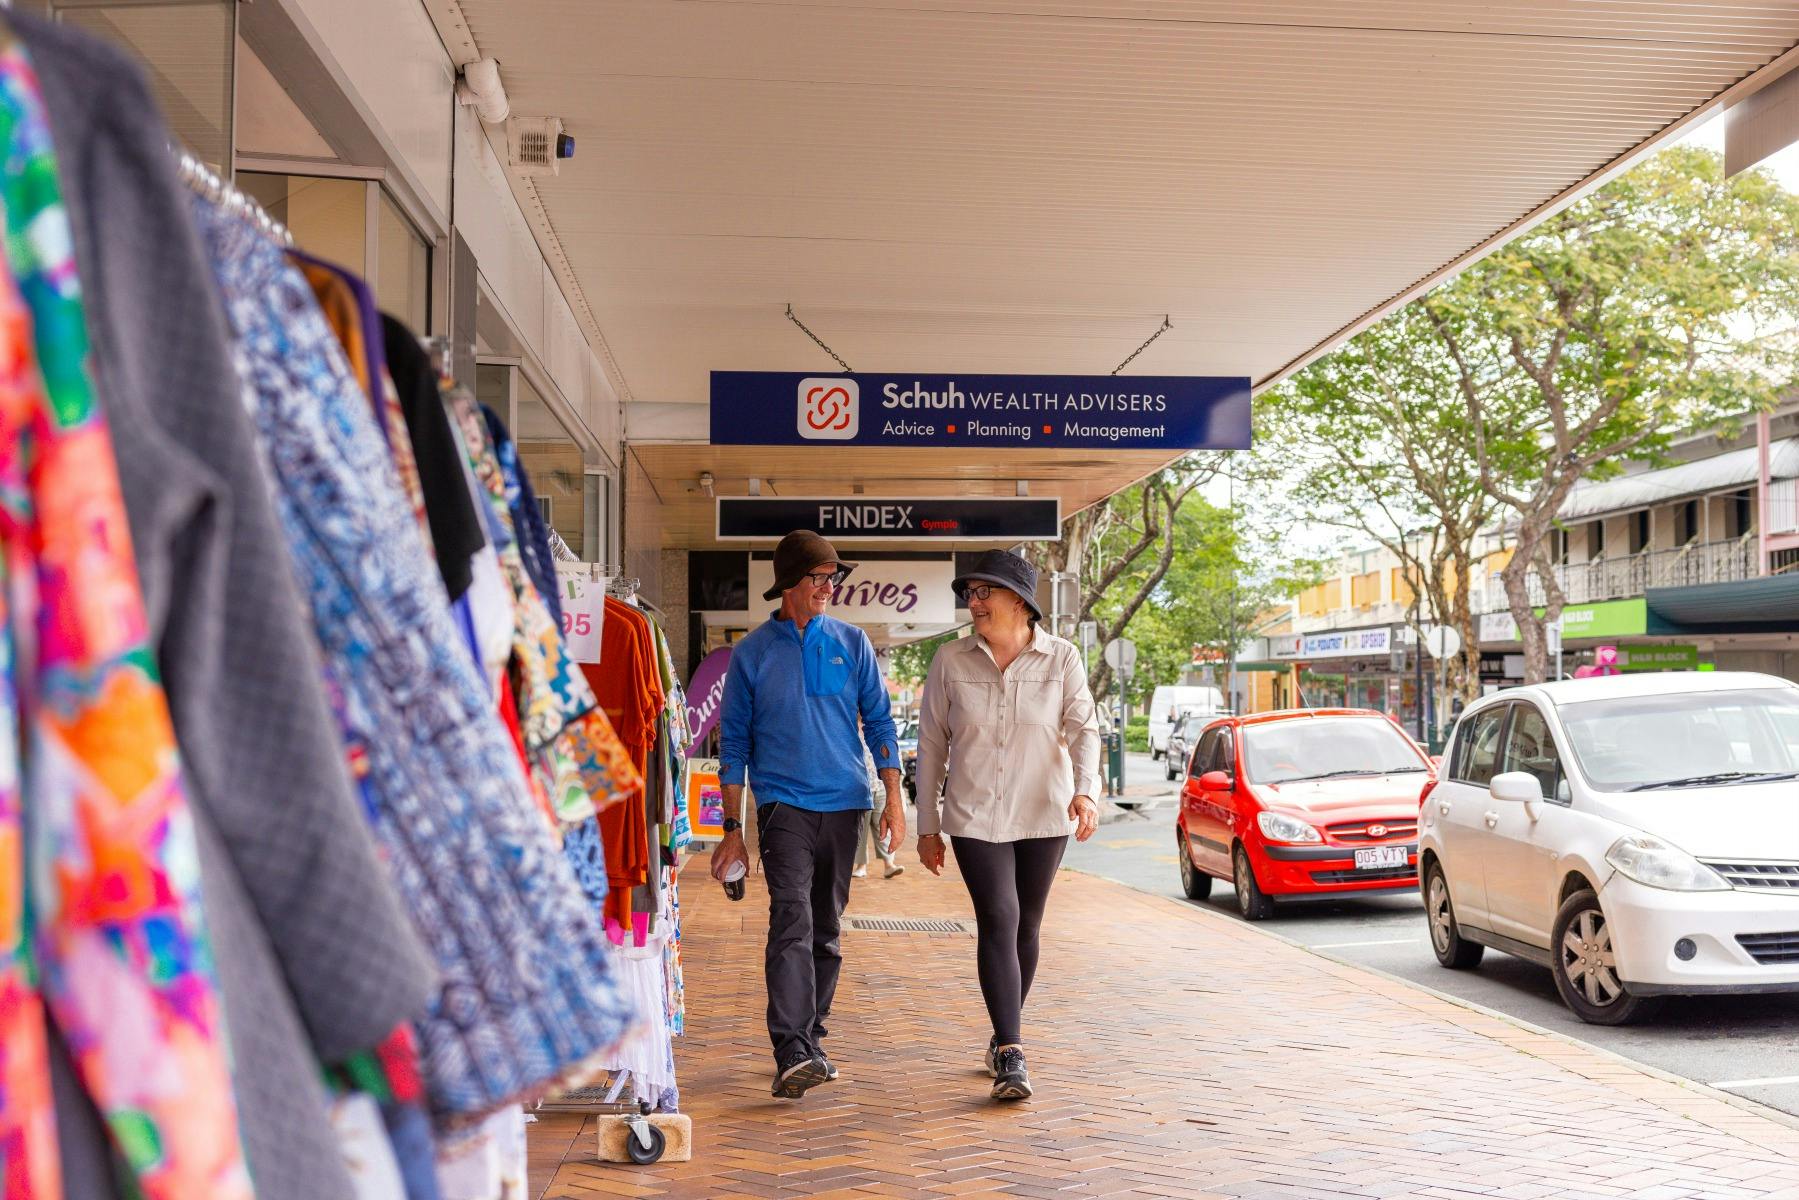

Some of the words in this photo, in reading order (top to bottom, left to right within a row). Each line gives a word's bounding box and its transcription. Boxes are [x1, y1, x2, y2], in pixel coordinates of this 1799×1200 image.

[882, 381, 965, 409] Schuh
[969, 391, 1058, 410] WEALTH
[1064, 393, 1166, 412] ADVISERS
[882, 420, 935, 436] Advice
[967, 421, 1031, 440] Planning
[1064, 422, 1165, 441] Management
[819, 506, 913, 529] FINDEX
[1655, 651, 1689, 662] BLOCK
[1382, 848, 1406, 861] VTY
